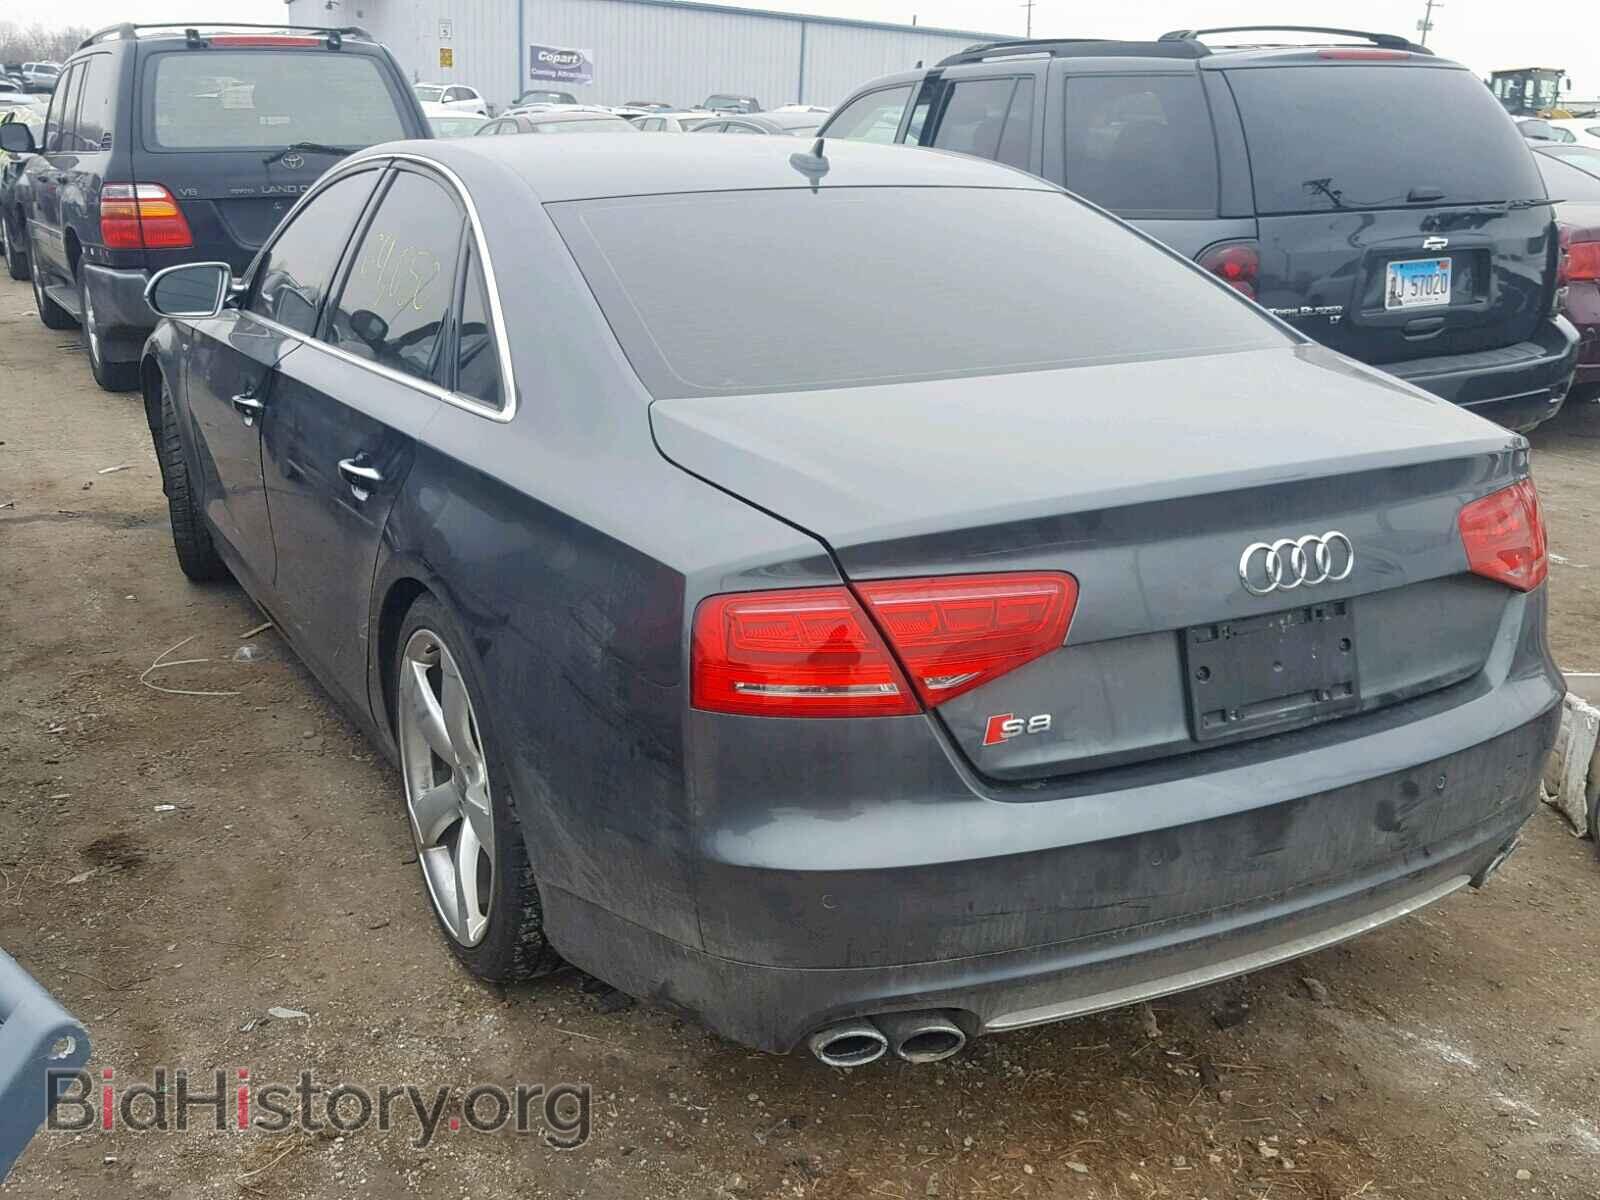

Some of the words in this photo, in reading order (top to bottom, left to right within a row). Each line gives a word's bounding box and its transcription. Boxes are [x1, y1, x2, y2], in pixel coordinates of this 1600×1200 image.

[538, 51, 578, 64] Copart
[261, 185, 297, 194] LAND
[1410, 273, 1448, 297] 57020
[1001, 714, 1051, 738] S8
